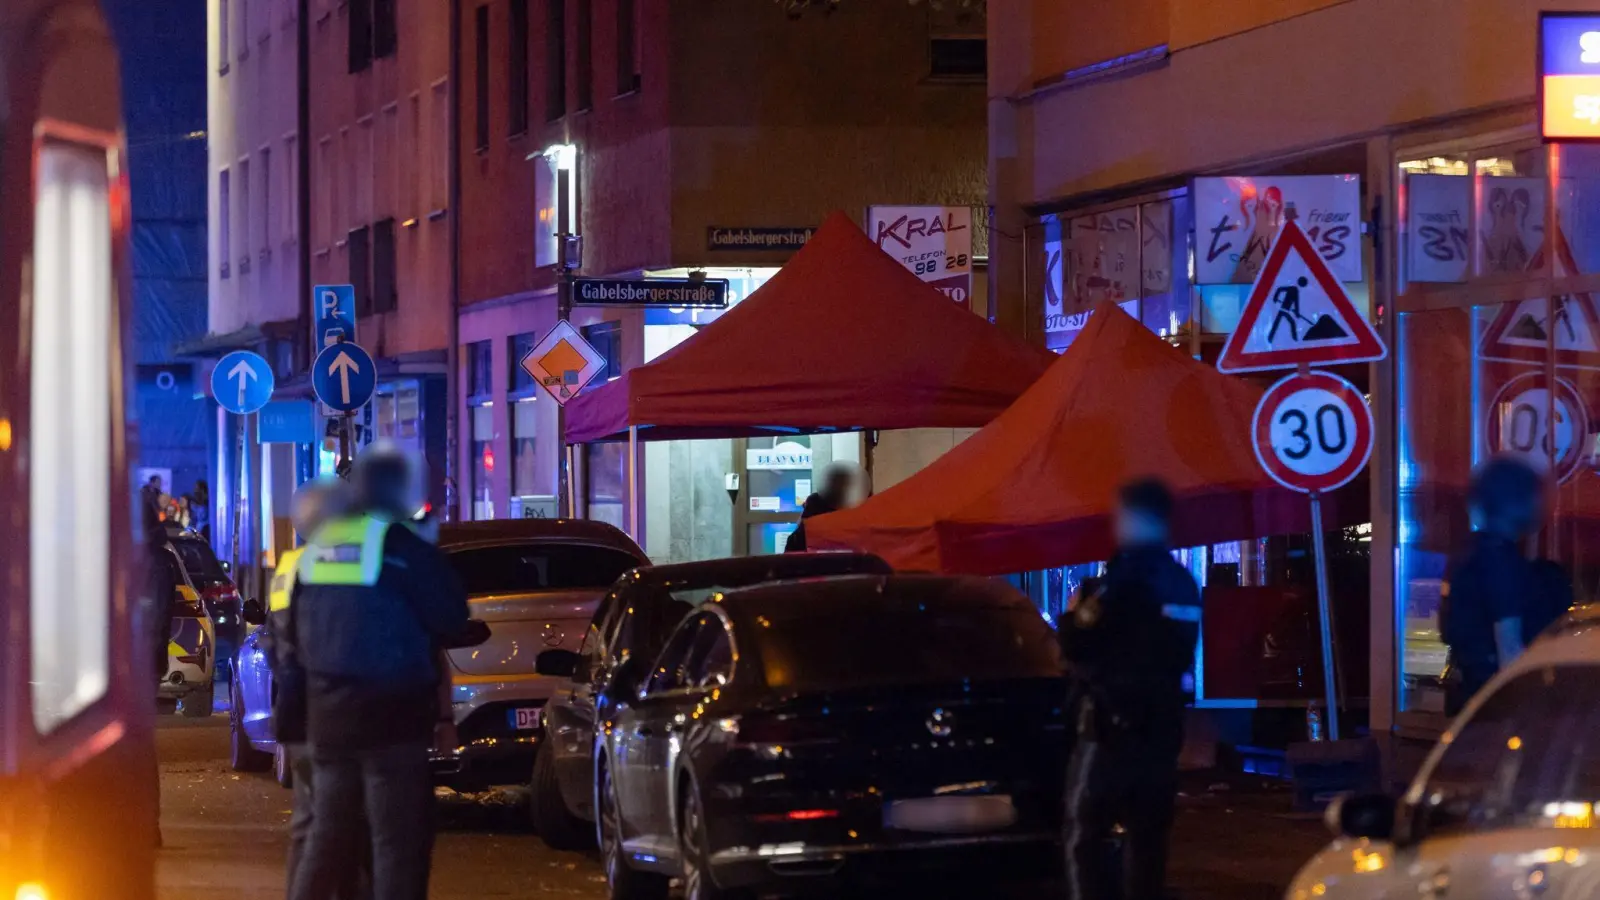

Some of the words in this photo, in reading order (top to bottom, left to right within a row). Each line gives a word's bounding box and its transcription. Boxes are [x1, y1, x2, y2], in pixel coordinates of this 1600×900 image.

[713, 229, 812, 247] Gabelsbergerstraß
[876, 212, 967, 250] KRAL
[901, 249, 947, 264] TELEFON
[914, 259, 937, 275] 98
[945, 253, 968, 270] 28
[581, 283, 716, 303] Gabelsbergerstraße
[938, 286, 966, 302] TO
[321, 290, 337, 319] P
[1279, 403, 1347, 460] 30
